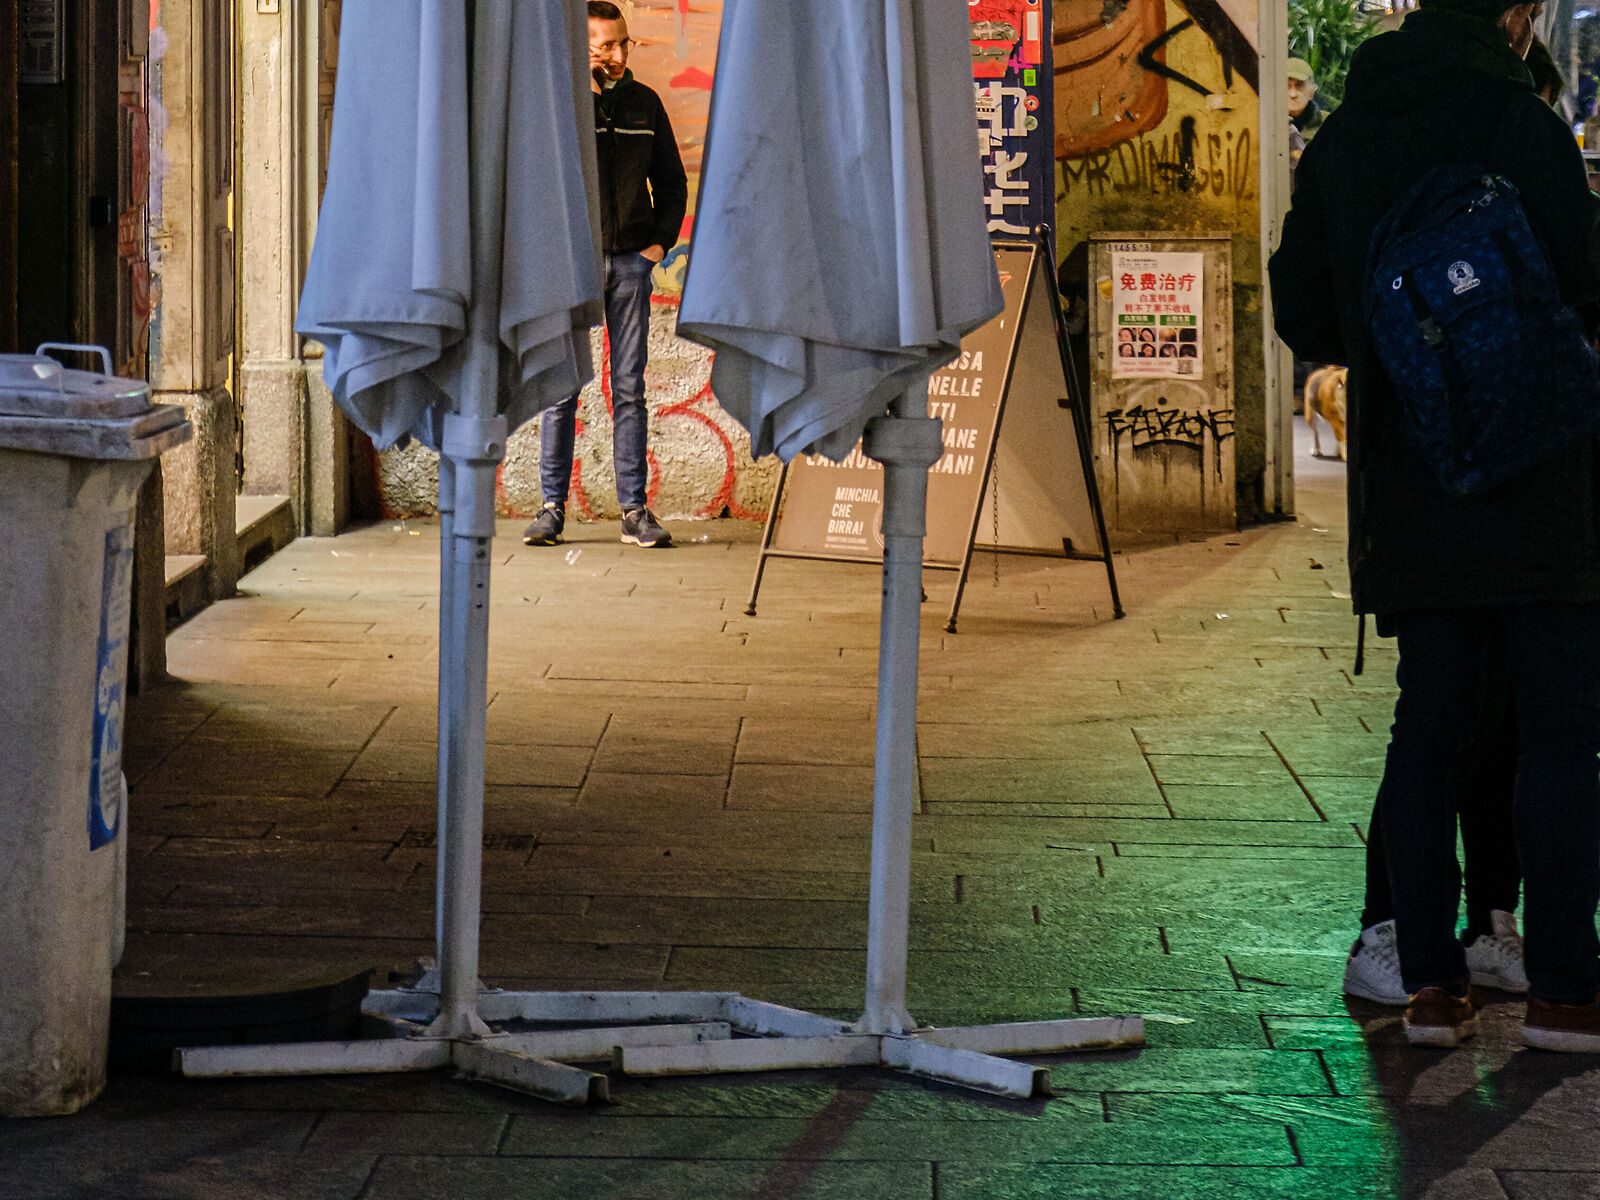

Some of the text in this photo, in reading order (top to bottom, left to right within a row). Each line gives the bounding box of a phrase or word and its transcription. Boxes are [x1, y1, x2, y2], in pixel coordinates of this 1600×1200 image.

[1120, 272, 1197, 292] 免费治疗
[832, 503, 853, 518] CHE
[828, 519, 864, 536] BIRRA!
